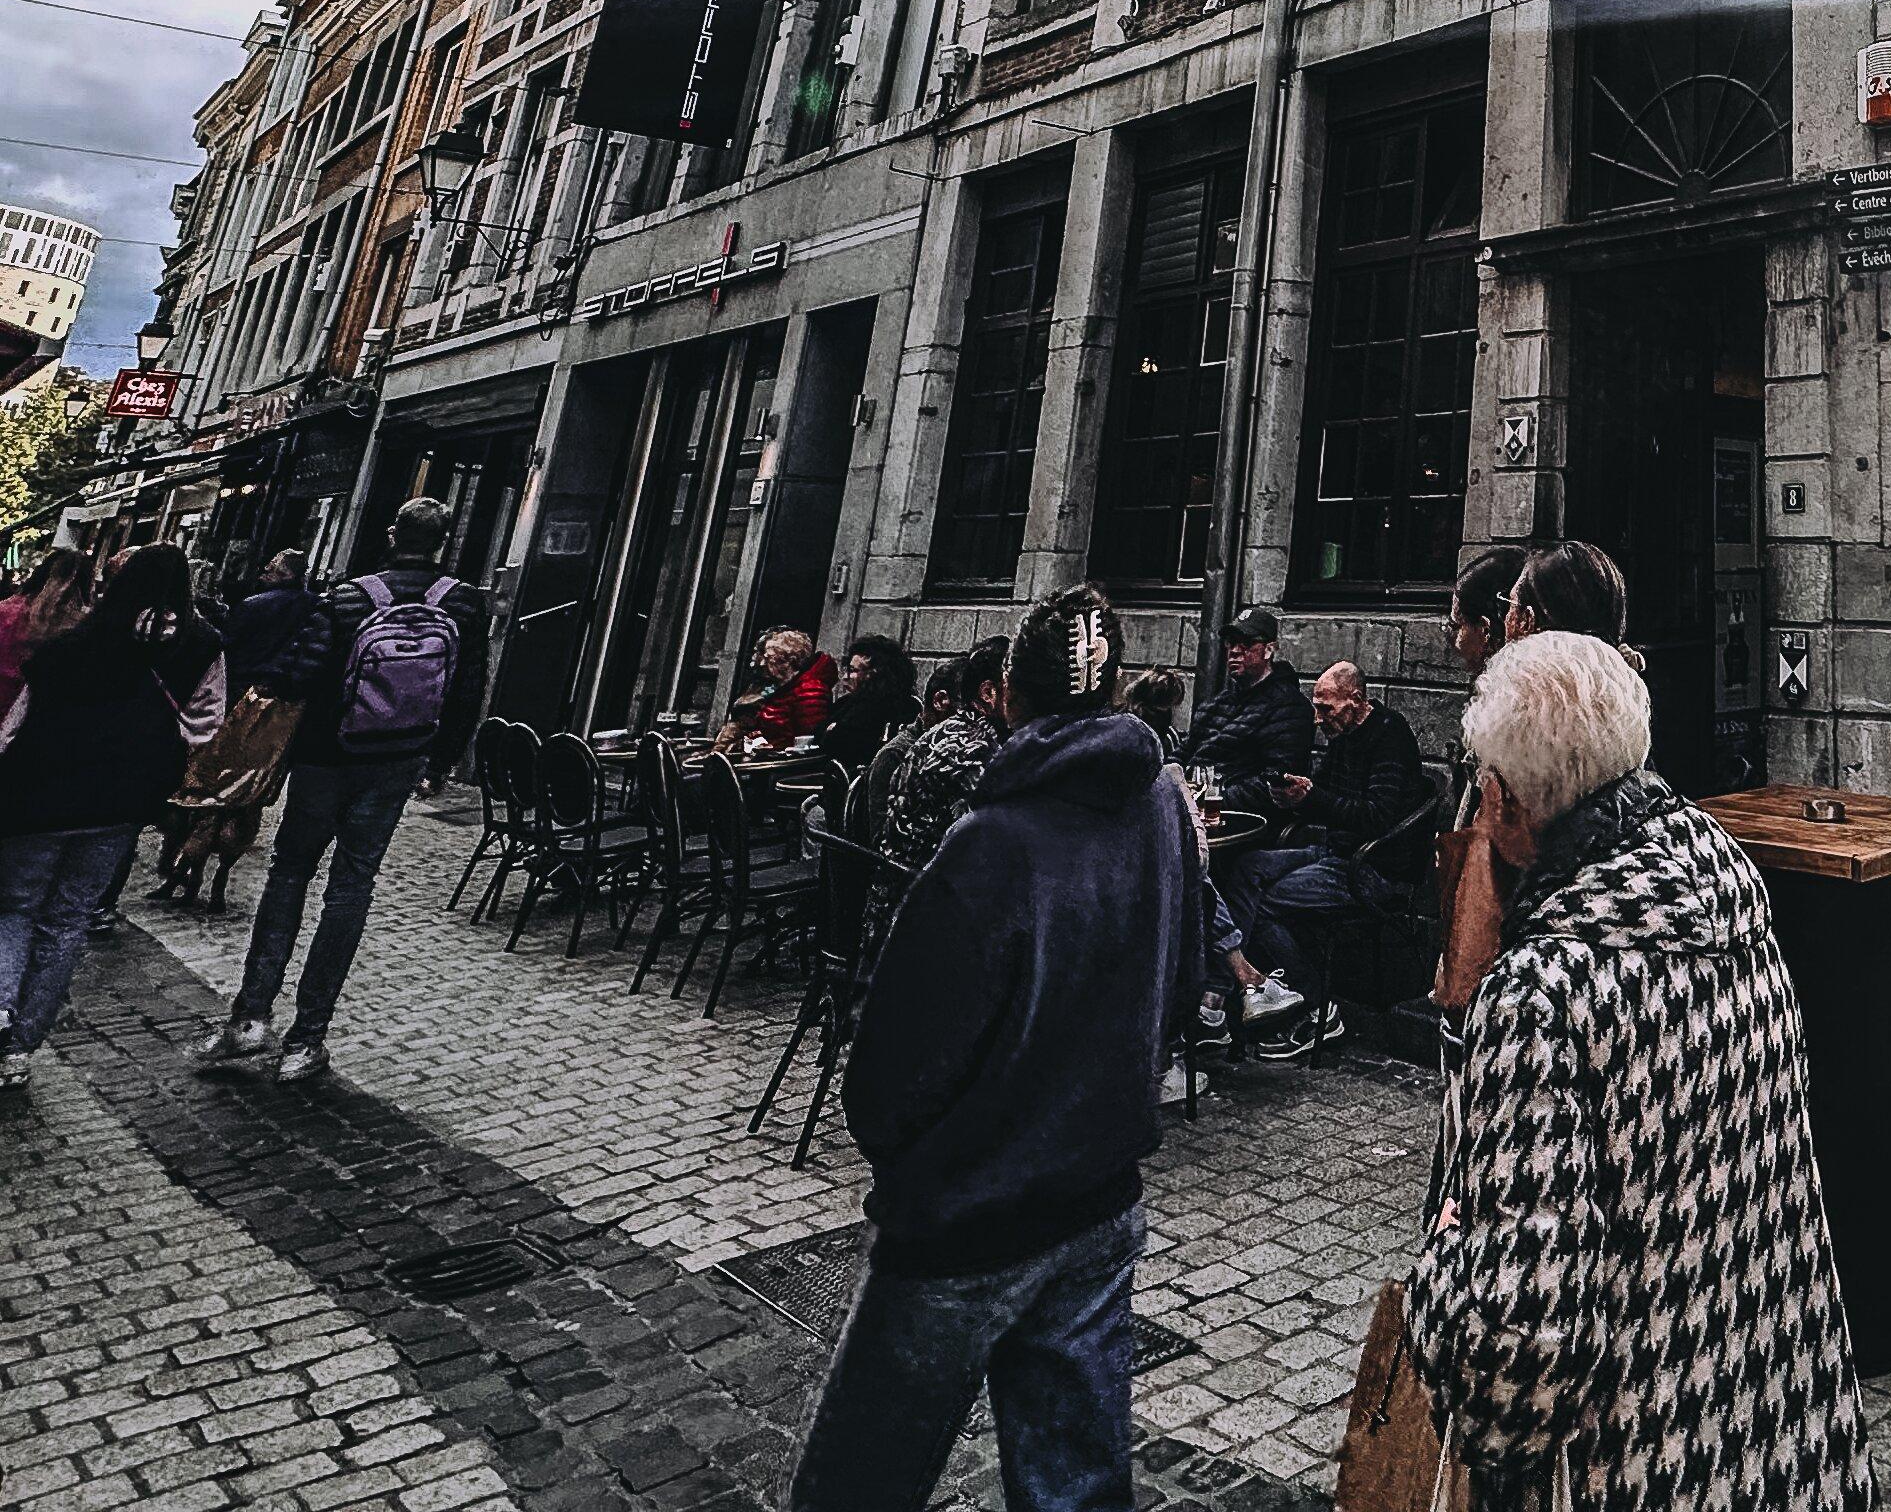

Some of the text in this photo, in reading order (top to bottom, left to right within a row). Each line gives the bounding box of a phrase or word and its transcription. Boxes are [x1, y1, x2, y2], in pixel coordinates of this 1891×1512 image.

[1852, 196, 1887, 210] Centre
[574, 241, 782, 319] STOFFELS
[127, 377, 166, 395] Chez
[112, 392, 167, 408] Alexis
[1789, 489, 1797, 507] 8
